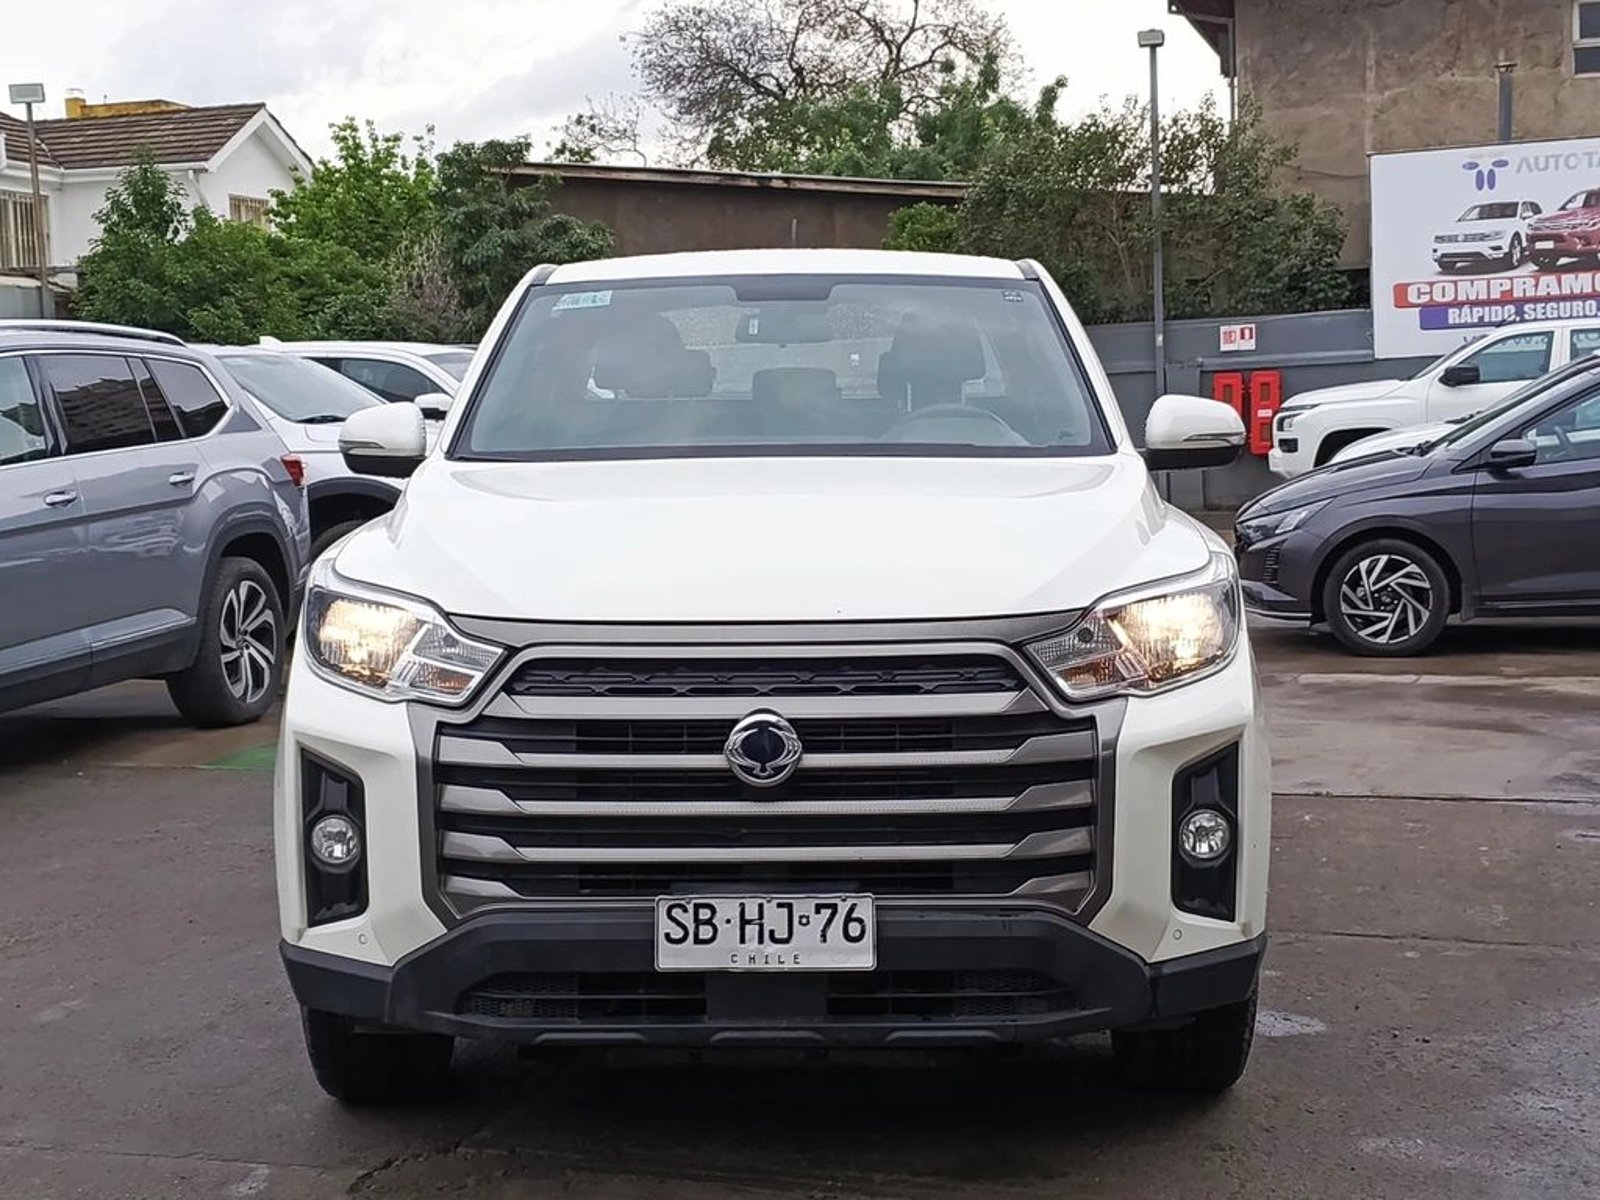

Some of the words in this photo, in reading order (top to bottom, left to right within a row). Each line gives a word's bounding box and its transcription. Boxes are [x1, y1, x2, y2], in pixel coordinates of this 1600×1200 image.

[1582, 151, 1600, 169] T
[1407, 273, 1600, 303] COMPRAM
[730, 954, 801, 965] CHILE
